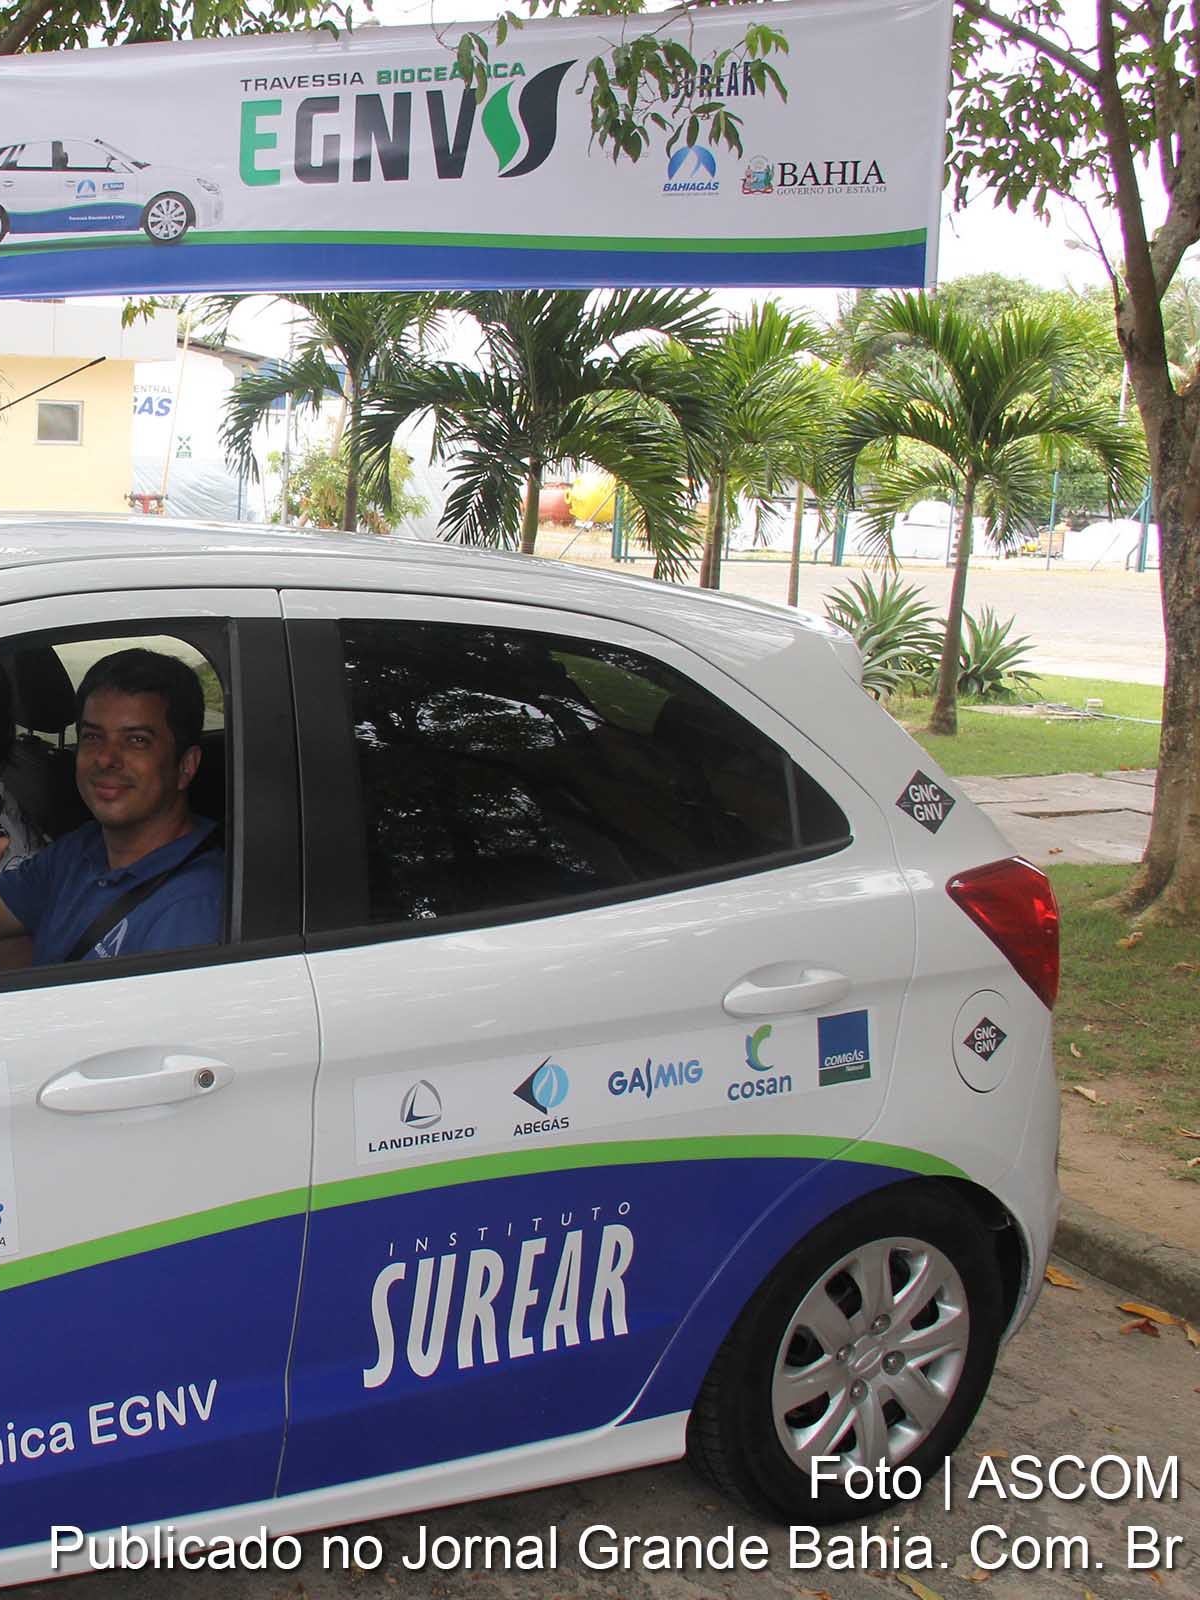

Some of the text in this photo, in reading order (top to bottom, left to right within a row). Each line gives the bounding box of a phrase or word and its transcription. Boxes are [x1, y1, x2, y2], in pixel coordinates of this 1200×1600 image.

[240, 71, 365, 93] TRAVESSIA
[239, 87, 478, 187] EGNV
[777, 160, 886, 187] BAHIA
[776, 185, 888, 196] GOVERNO DO ESTADO
[133, 384, 173, 394] ENTRAL
[908, 783, 940, 803] GNC
[913, 802, 943, 822] GNV
[974, 1025, 997, 1041] GNC
[974, 1038, 997, 1054] GNV
[726, 1073, 793, 1101] cosan
[368, 1126, 476, 1153] LANDIRENZO
[388, 1201, 631, 1258] INSTITUTO
[362, 1223, 635, 1389] SUREAR
[87, 1378, 219, 1447] EGNV
